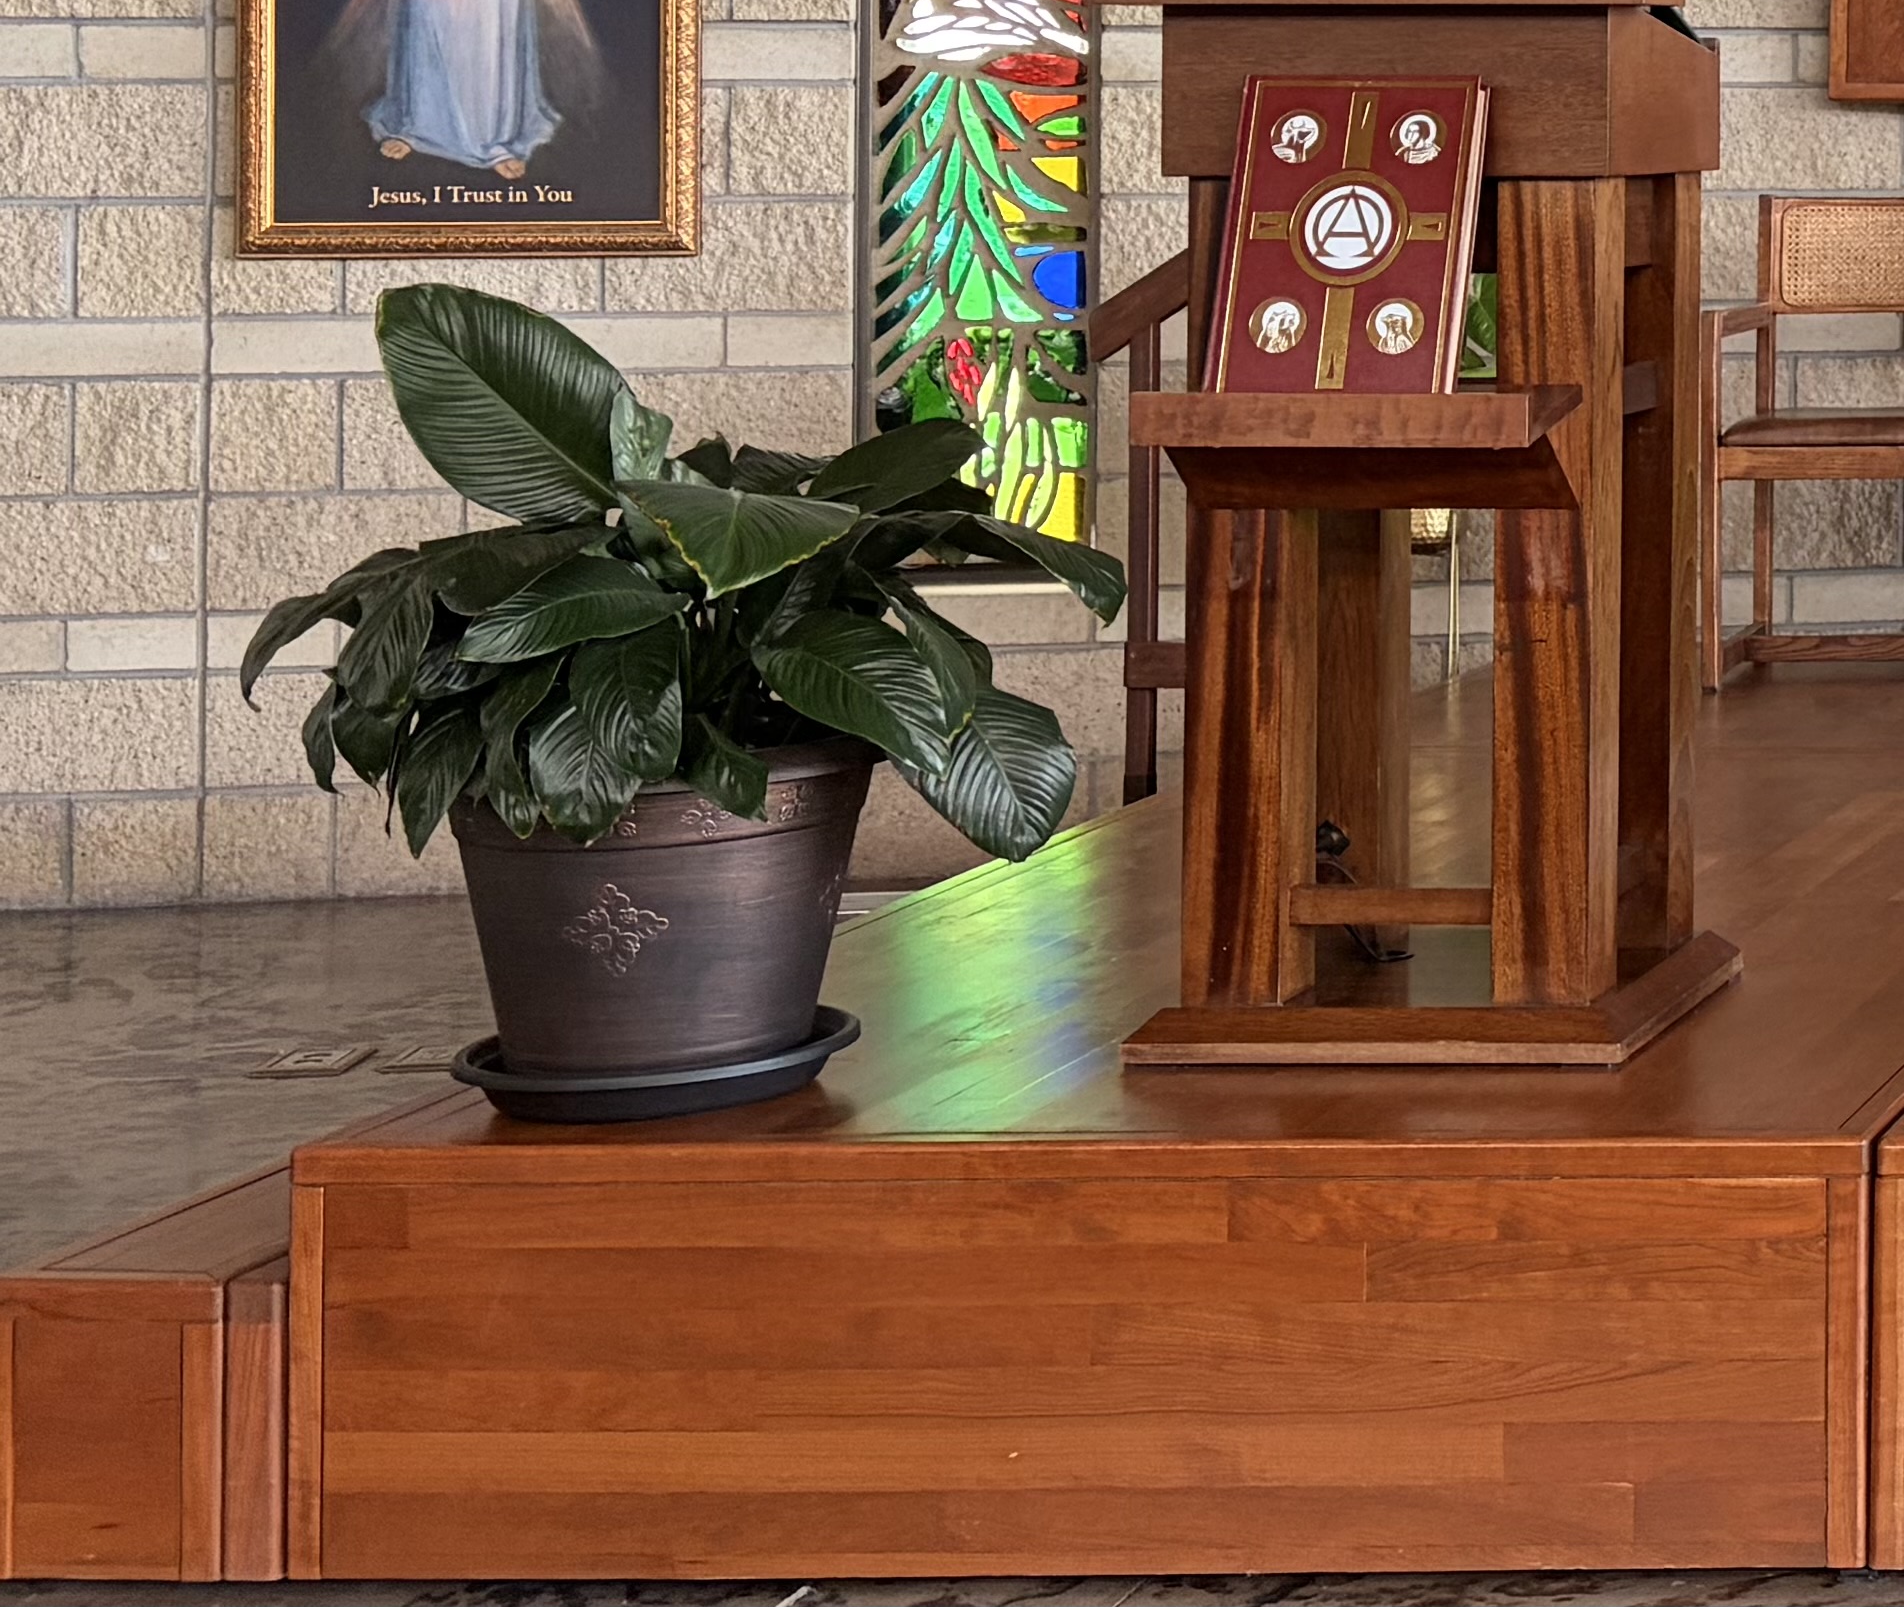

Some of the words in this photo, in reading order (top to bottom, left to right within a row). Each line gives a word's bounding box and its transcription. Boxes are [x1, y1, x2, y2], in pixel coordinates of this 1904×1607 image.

[368, 186, 427, 208] Jesus,
[433, 186, 441, 202] I
[447, 185, 503, 203] Trust
[508, 186, 528, 202] in
[534, 185, 573, 202] You
